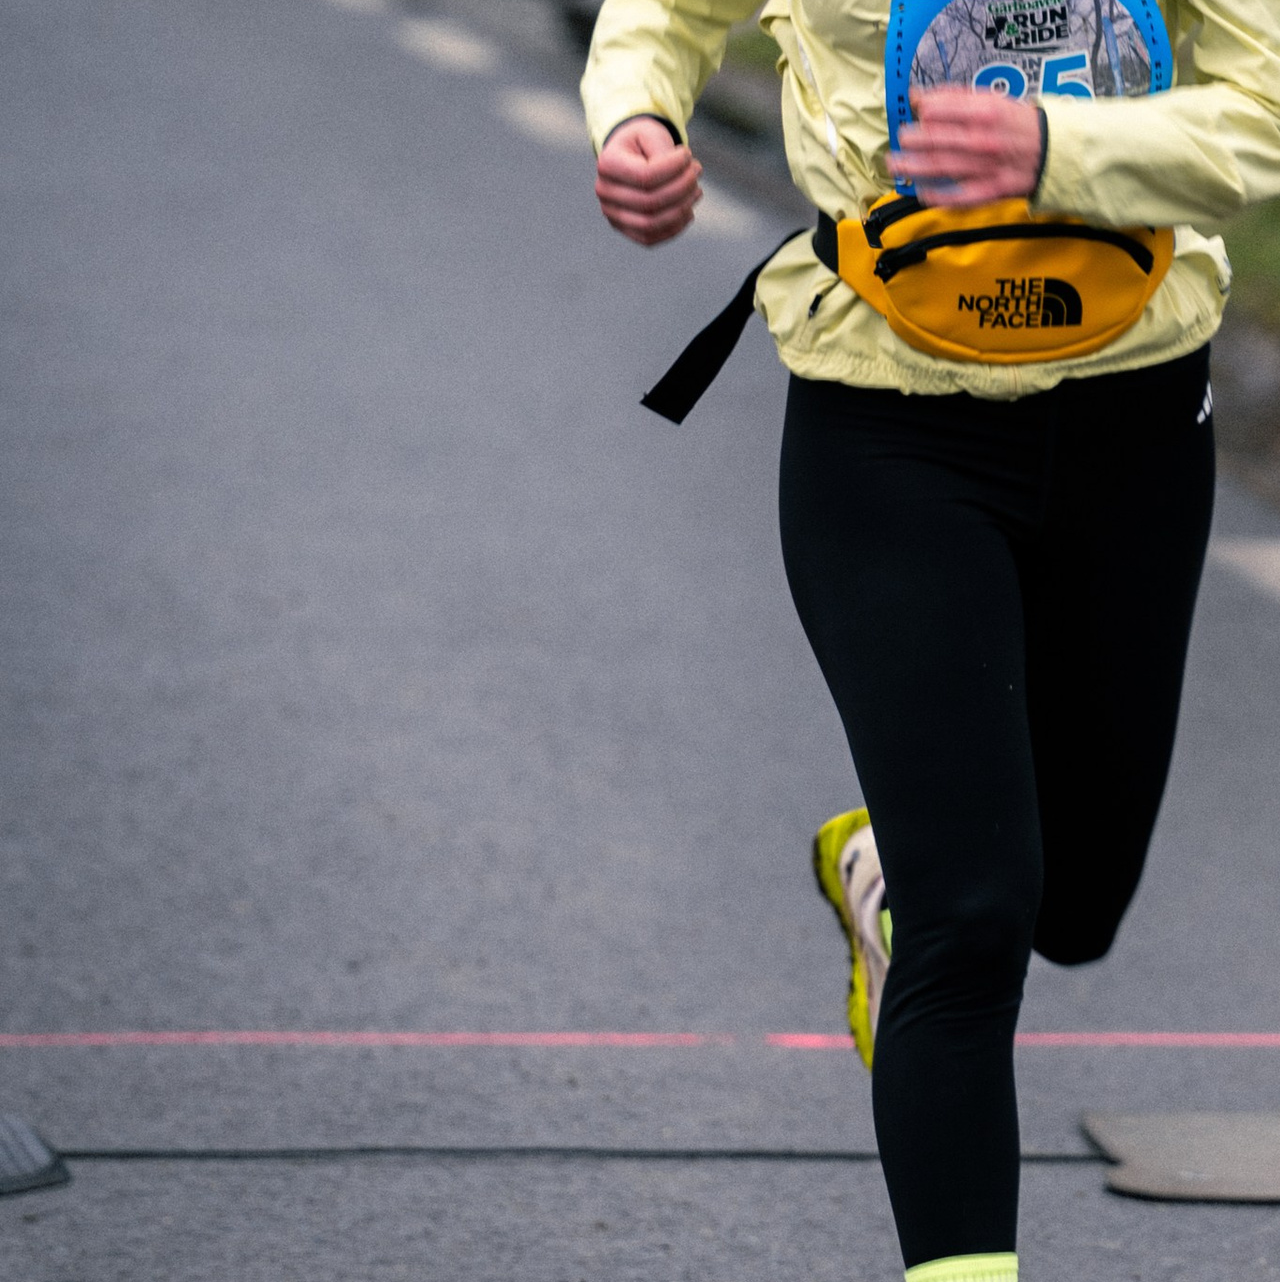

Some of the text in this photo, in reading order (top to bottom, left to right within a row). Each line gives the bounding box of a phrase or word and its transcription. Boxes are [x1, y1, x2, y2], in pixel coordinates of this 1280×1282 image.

[1013, 6, 1068, 28] RUN
[1006, 22, 1018, 36] &
[1015, 24, 1069, 45] RIDE
[995, 278, 1042, 296] THE
[958, 295, 1042, 313] NORTH
[979, 313, 1040, 329] FACE
